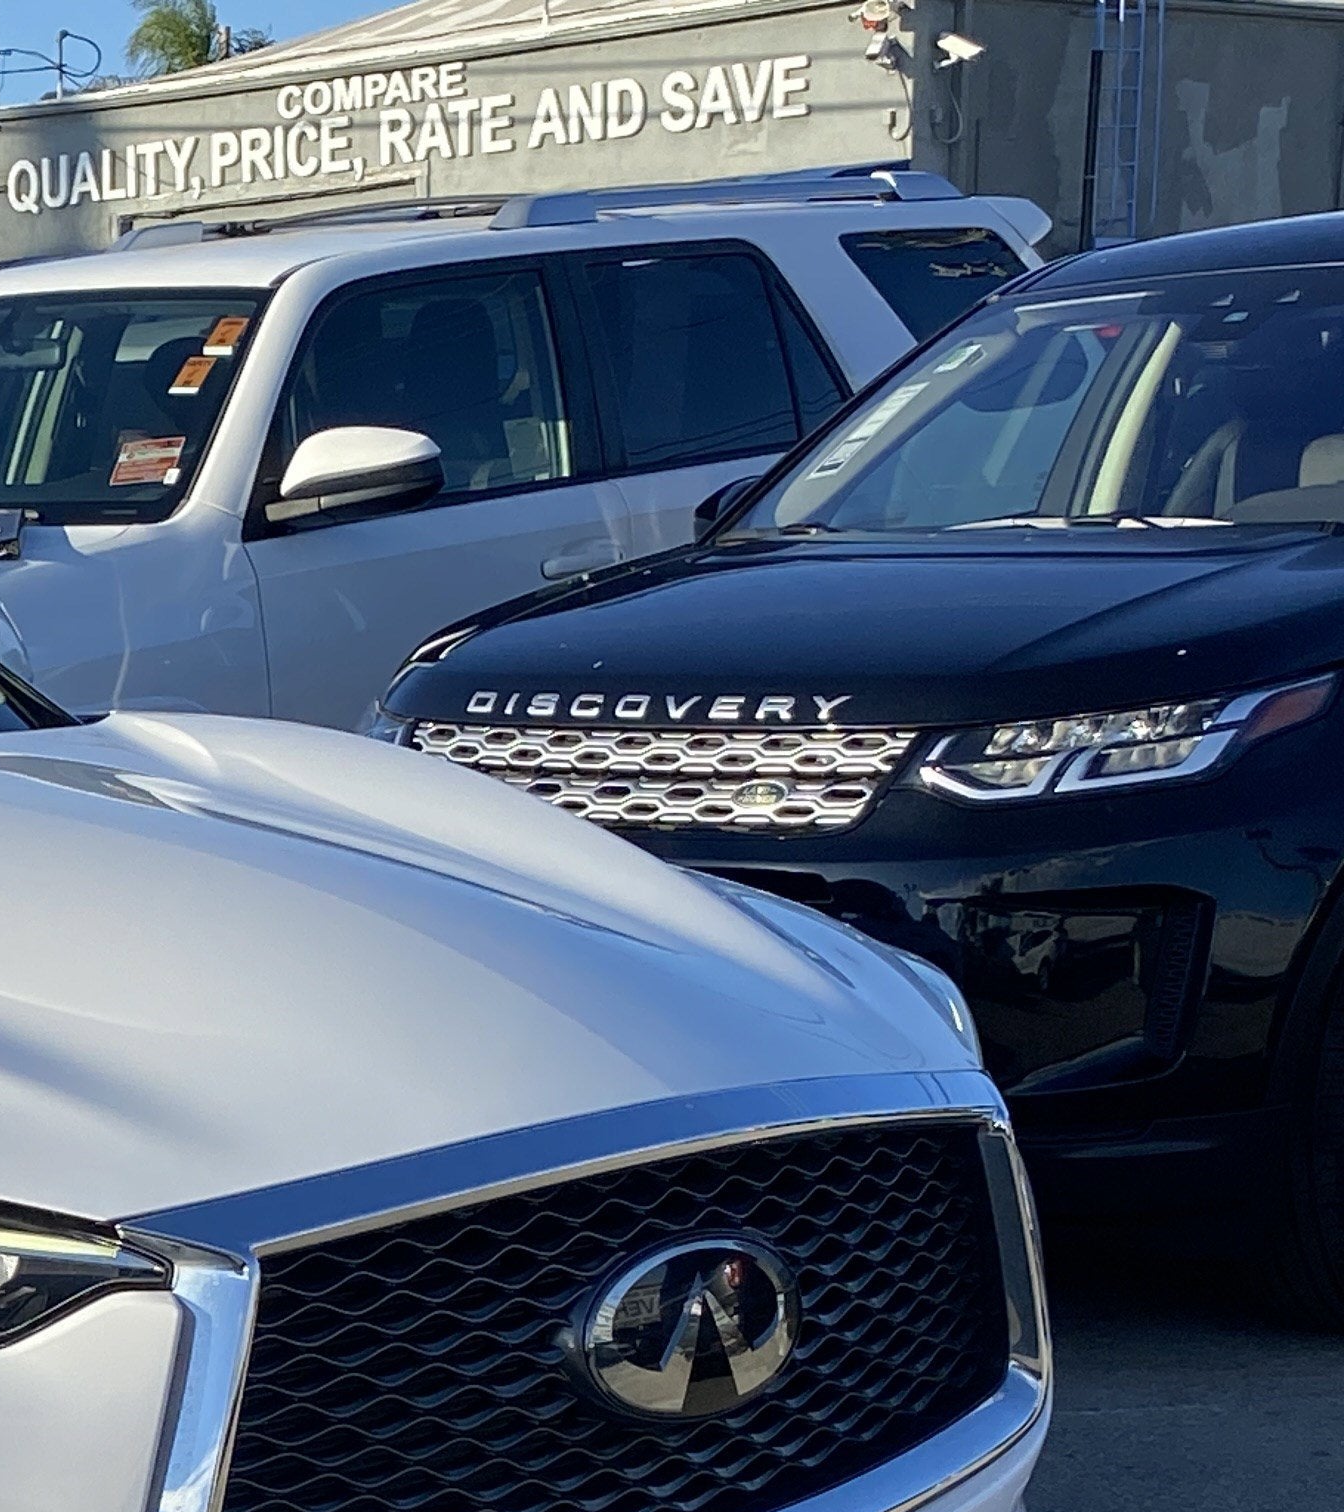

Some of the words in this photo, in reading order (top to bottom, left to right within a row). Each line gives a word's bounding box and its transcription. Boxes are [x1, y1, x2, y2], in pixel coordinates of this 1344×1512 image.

[276, 62, 468, 120] COMPARE
[7, 136, 205, 215] QUALITY,
[211, 116, 365, 188] PRICE,
[378, 93, 514, 167] RATE
[528, 77, 648, 149] AND
[660, 54, 812, 133] SAVE
[466, 690, 853, 721] DISCOVERY
